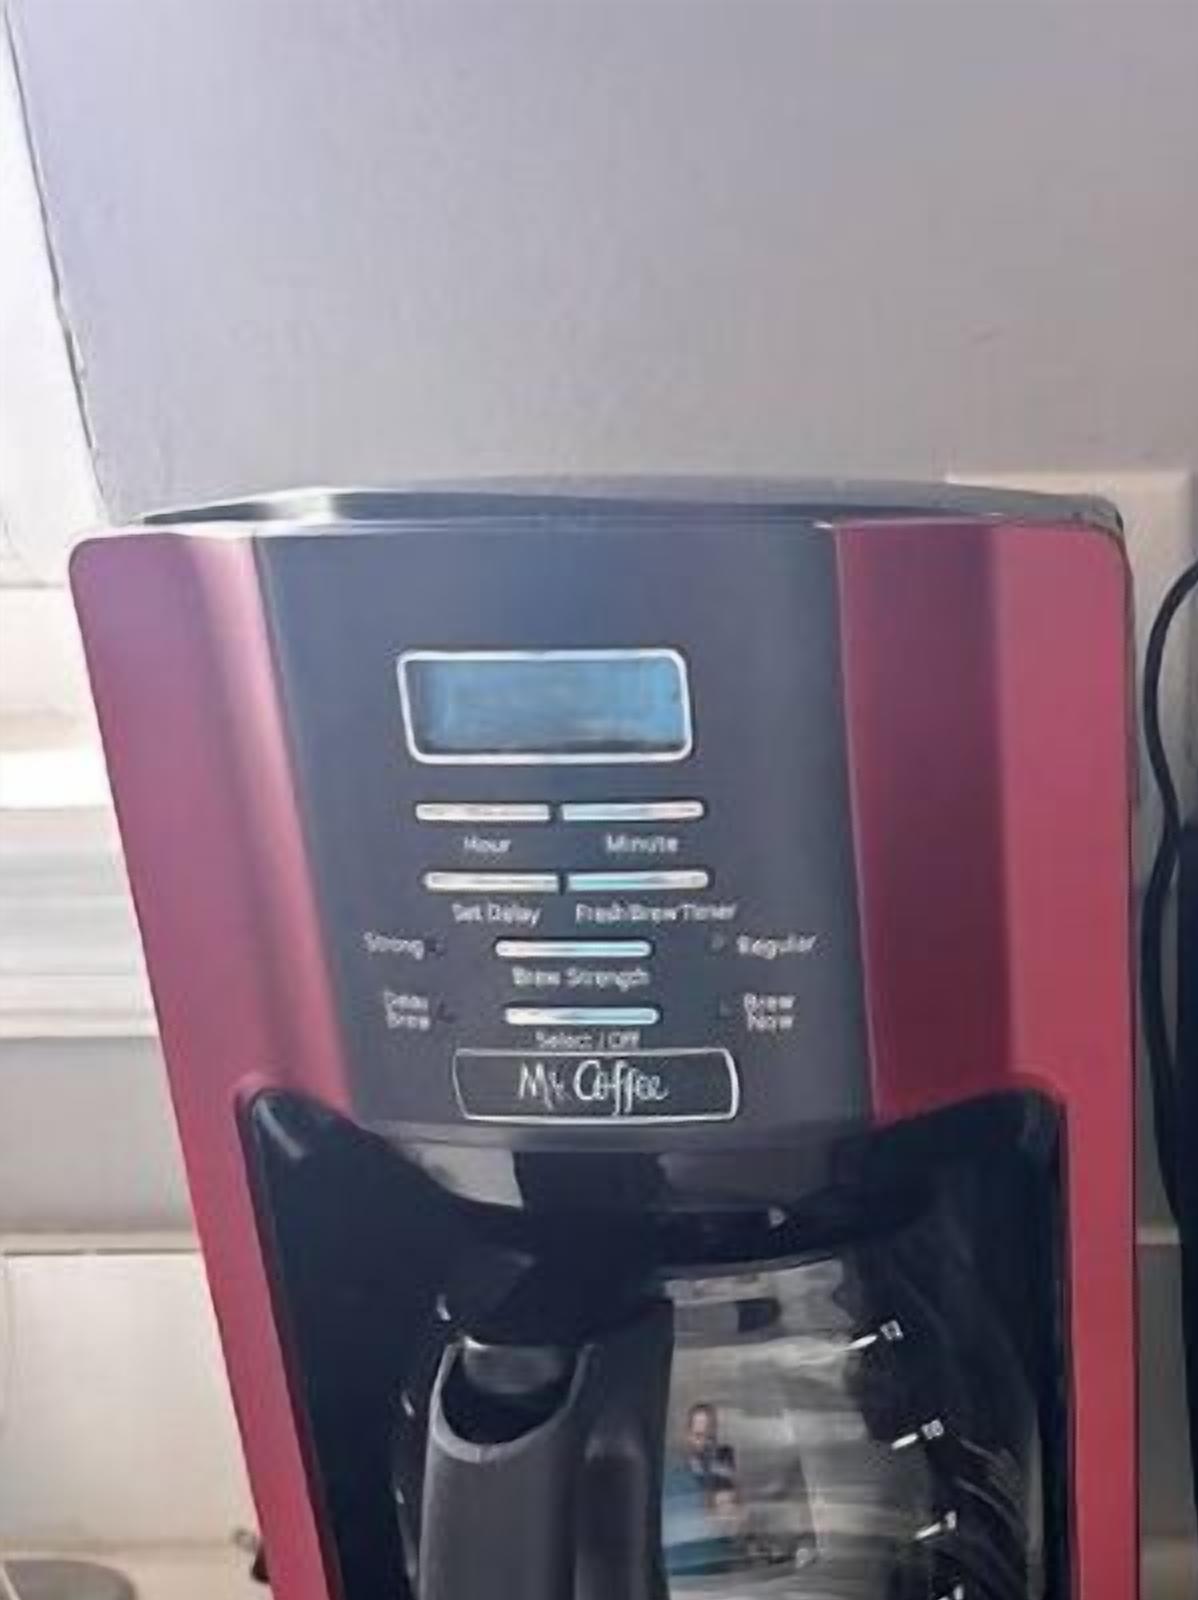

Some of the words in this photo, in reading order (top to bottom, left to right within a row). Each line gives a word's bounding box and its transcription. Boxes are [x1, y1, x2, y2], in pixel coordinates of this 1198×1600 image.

[463, 836, 511, 852] Hour
[606, 834, 678, 853] Minute
[573, 1059, 671, 1116] Coffee
